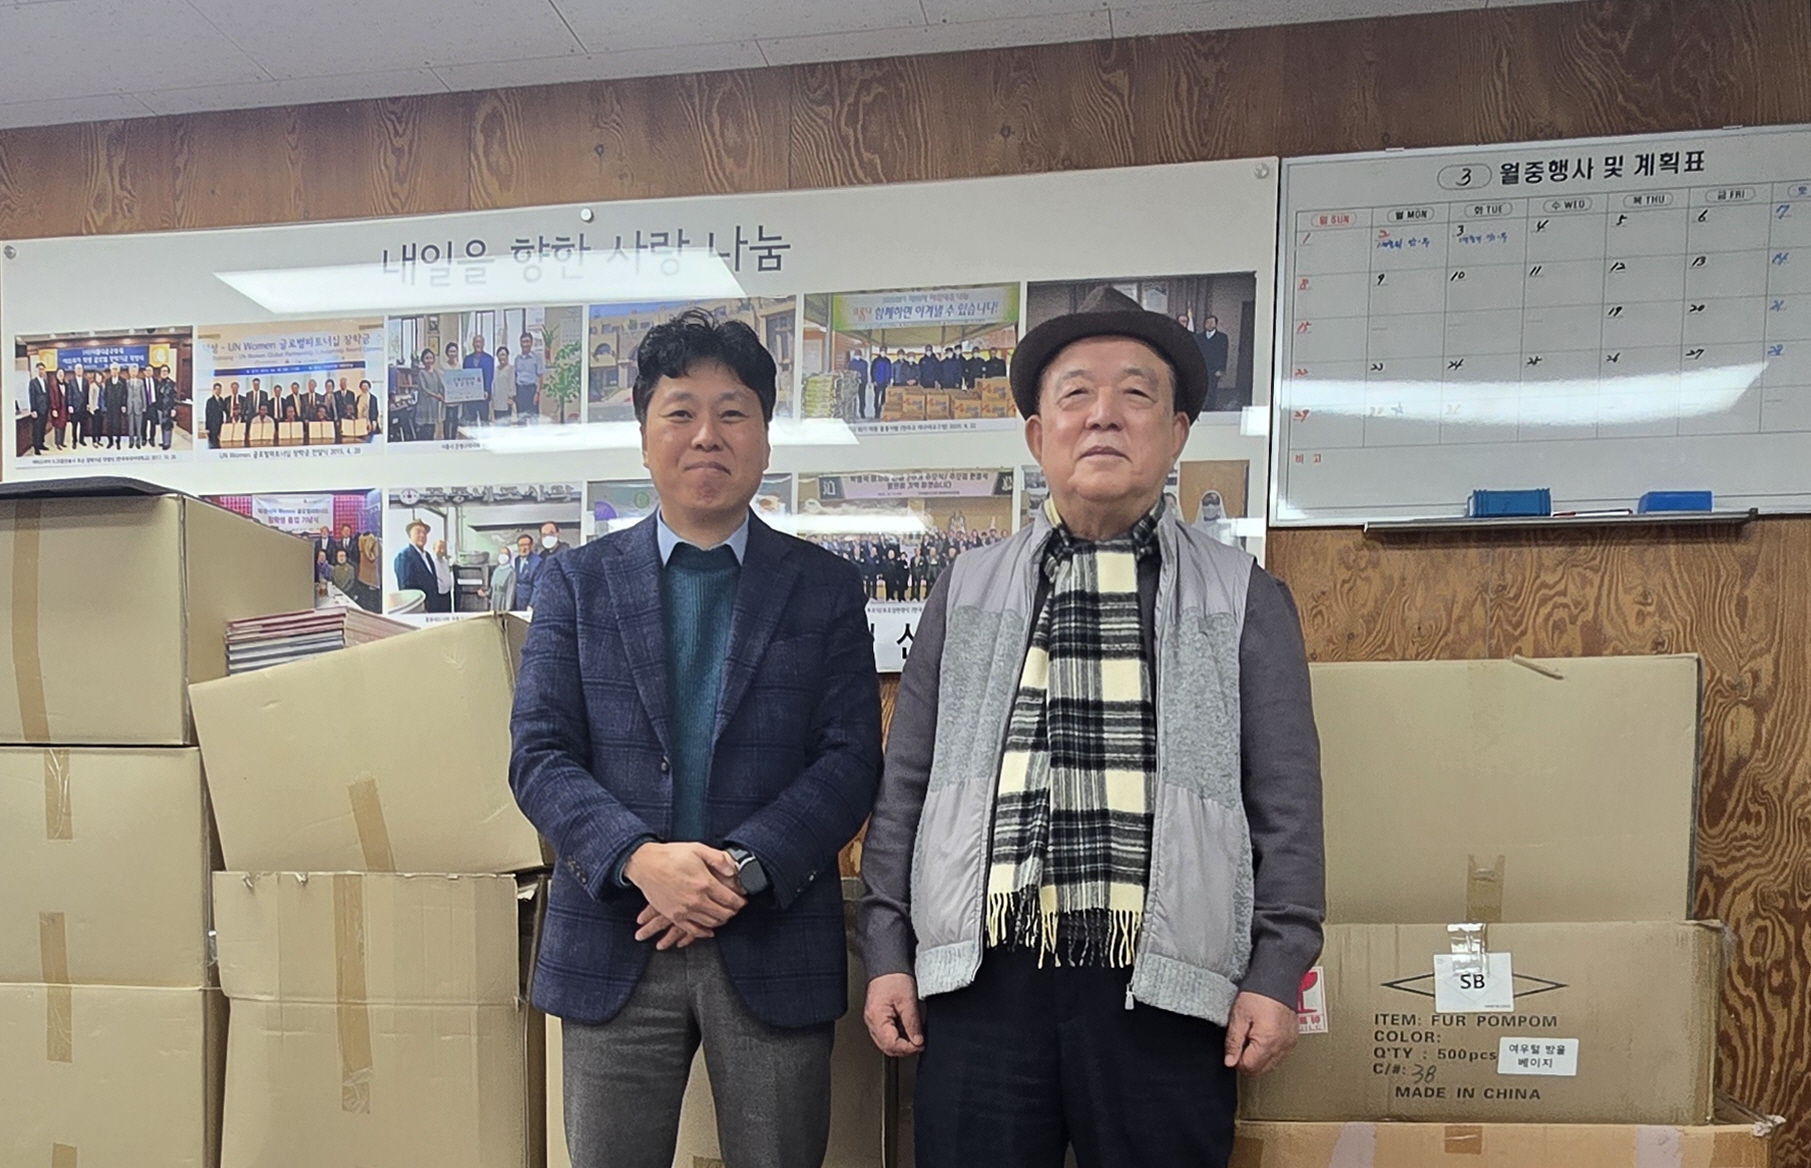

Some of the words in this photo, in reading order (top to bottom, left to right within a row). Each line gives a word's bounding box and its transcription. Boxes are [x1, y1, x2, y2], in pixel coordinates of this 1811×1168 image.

[1455, 168, 1472, 186] 3
[1500, 156, 1594, 185] 월중행사
[1604, 155, 1624, 179] 및
[1634, 150, 1706, 177] 계획표
[1646, 195, 1665, 205] THU
[1717, 191, 1726, 200] 금
[1729, 190, 1745, 199] FRI
[1486, 205, 1502, 215] TUE
[1551, 201, 1560, 210] 수
[1407, 209, 1428, 219] MON
[1697, 209, 1708, 222] 6
[1775, 204, 1790, 219] 7
[1331, 215, 1350, 225] SUN
[1536, 219, 1549, 232] 4
[1616, 215, 1627, 226] 5
[1455, 225, 1465, 236] 3
[382, 239, 495, 287] 내일을
[510, 234, 591, 283] 향한
[607, 228, 690, 276] 사랑
[708, 225, 791, 272] 나눔
[1692, 256, 1706, 267] 13
[1529, 266, 1542, 276] 11
[1609, 262, 1626, 272] 12
[1376, 274, 1385, 285] 9
[1450, 271, 1466, 282] 10
[946, 305, 955, 317] 수
[1607, 306, 1622, 317] 19
[244, 341, 276, 351] Women
[1460, 973, 1485, 989] SB
[1374, 1014, 1421, 1026] ITEM:
[1431, 1014, 1466, 1027] FUR
[1477, 1015, 1558, 1027] POMPOM
[1374, 1031, 1441, 1043] COLOR:
[1374, 1047, 1413, 1060] Q'TY
[1437, 1049, 1497, 1062] 500pcs
[1508, 1043, 1541, 1055] 여우털
[1545, 1044, 1566, 1055] 방울
[1518, 1058, 1553, 1068] 베이지
[1373, 1064, 1406, 1075] C/#:
[1411, 1065, 1437, 1084] 38
[1395, 1086, 1446, 1099] MADE
[1457, 1087, 1476, 1099] IN
[1484, 1087, 1541, 1100] CHINA
